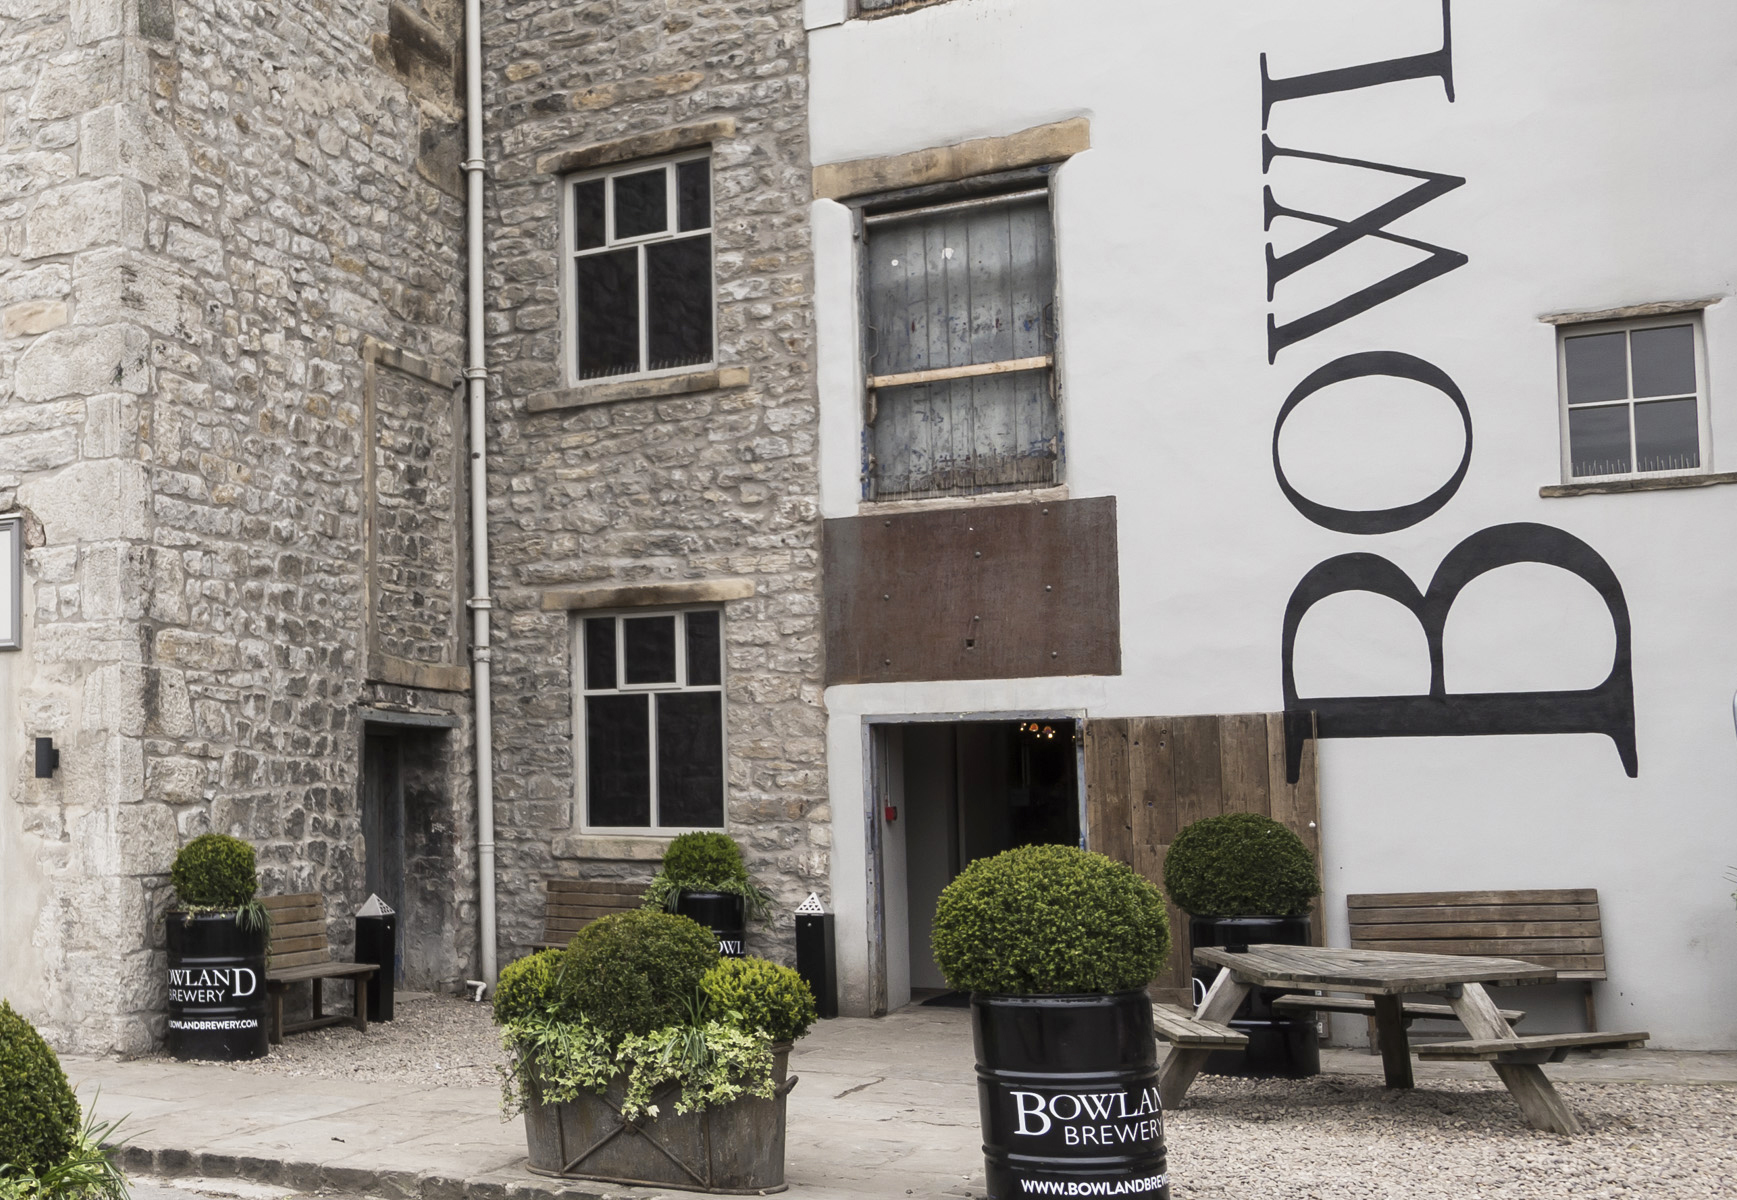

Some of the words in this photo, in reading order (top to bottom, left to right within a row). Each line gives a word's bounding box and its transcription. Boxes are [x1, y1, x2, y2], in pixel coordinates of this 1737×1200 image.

[168, 968, 257, 997] OWLAND
[1010, 1087, 1163, 1136] BOWLAN
[1064, 1118, 1163, 1145] BREWERY
